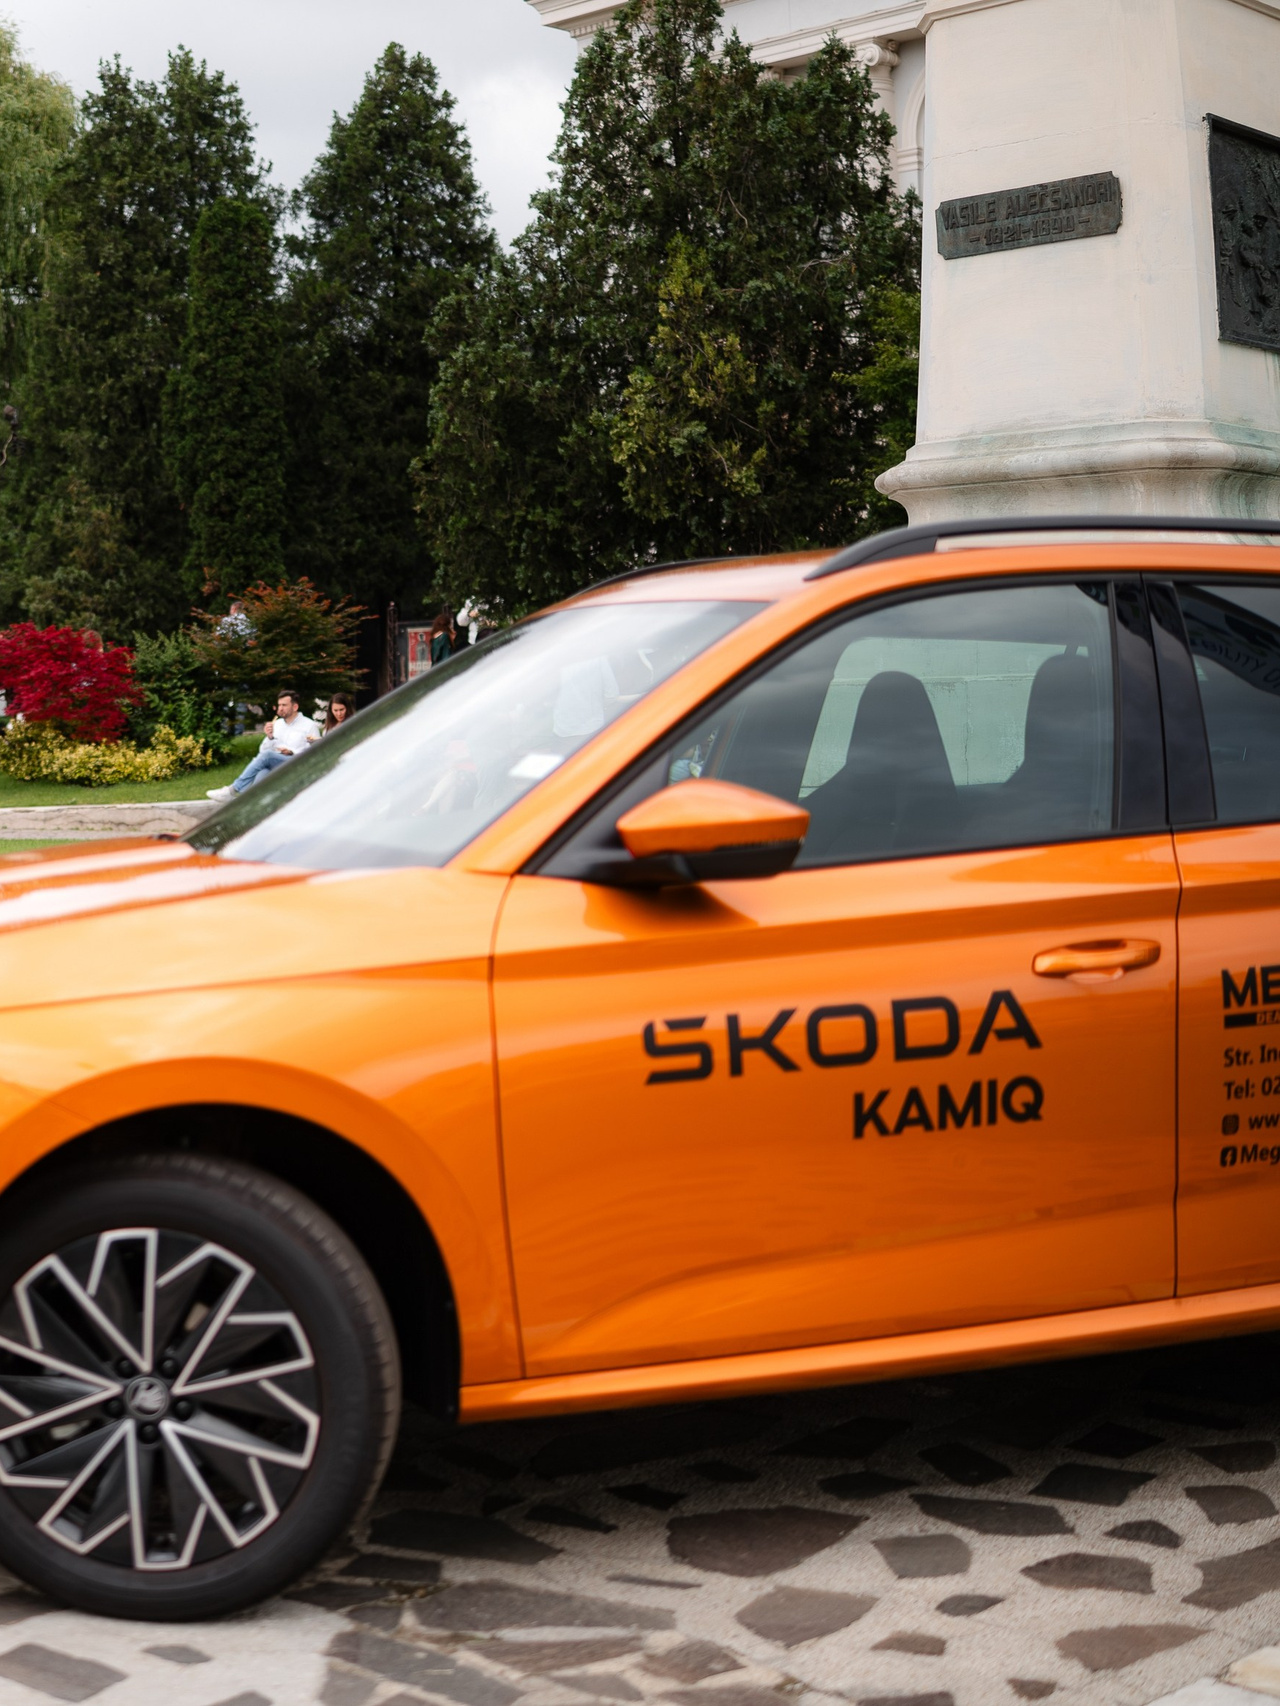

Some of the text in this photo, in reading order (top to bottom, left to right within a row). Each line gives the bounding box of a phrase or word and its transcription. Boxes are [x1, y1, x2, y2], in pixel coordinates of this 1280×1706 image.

[940, 199, 996, 230] VASILE
[1222, 964, 1280, 1009] ME
[1224, 1044, 1280, 1067] Str. In
[1223, 1078, 1255, 1100] Tel:
[852, 1075, 1045, 1140] KAMIQ
